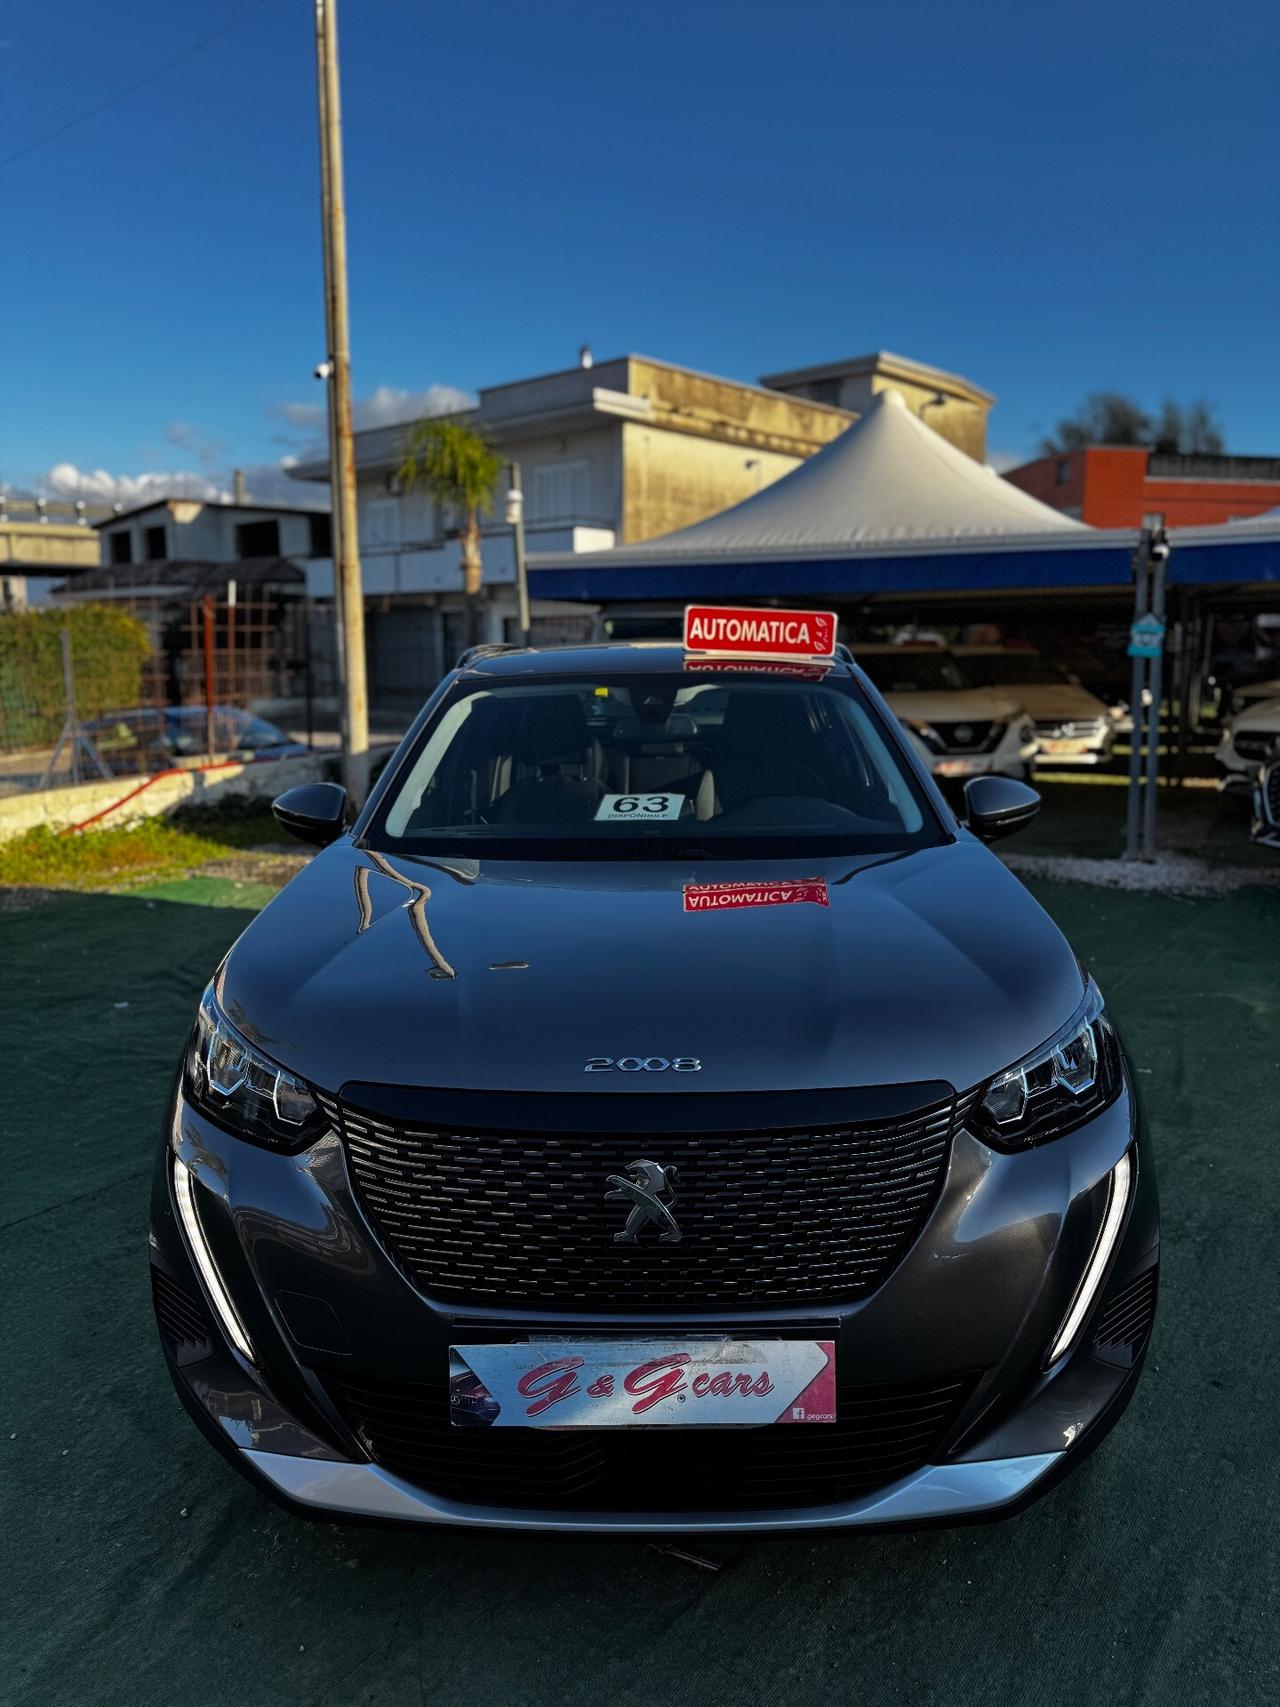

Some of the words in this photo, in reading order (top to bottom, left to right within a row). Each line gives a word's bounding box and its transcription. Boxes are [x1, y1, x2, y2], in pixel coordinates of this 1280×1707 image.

[690, 617, 810, 644] AUTOMATICA
[613, 796, 669, 813] 63
[584, 1057, 702, 1072] 2008
[586, 1374, 616, 1398] &
[691, 1371, 774, 1398] cars
